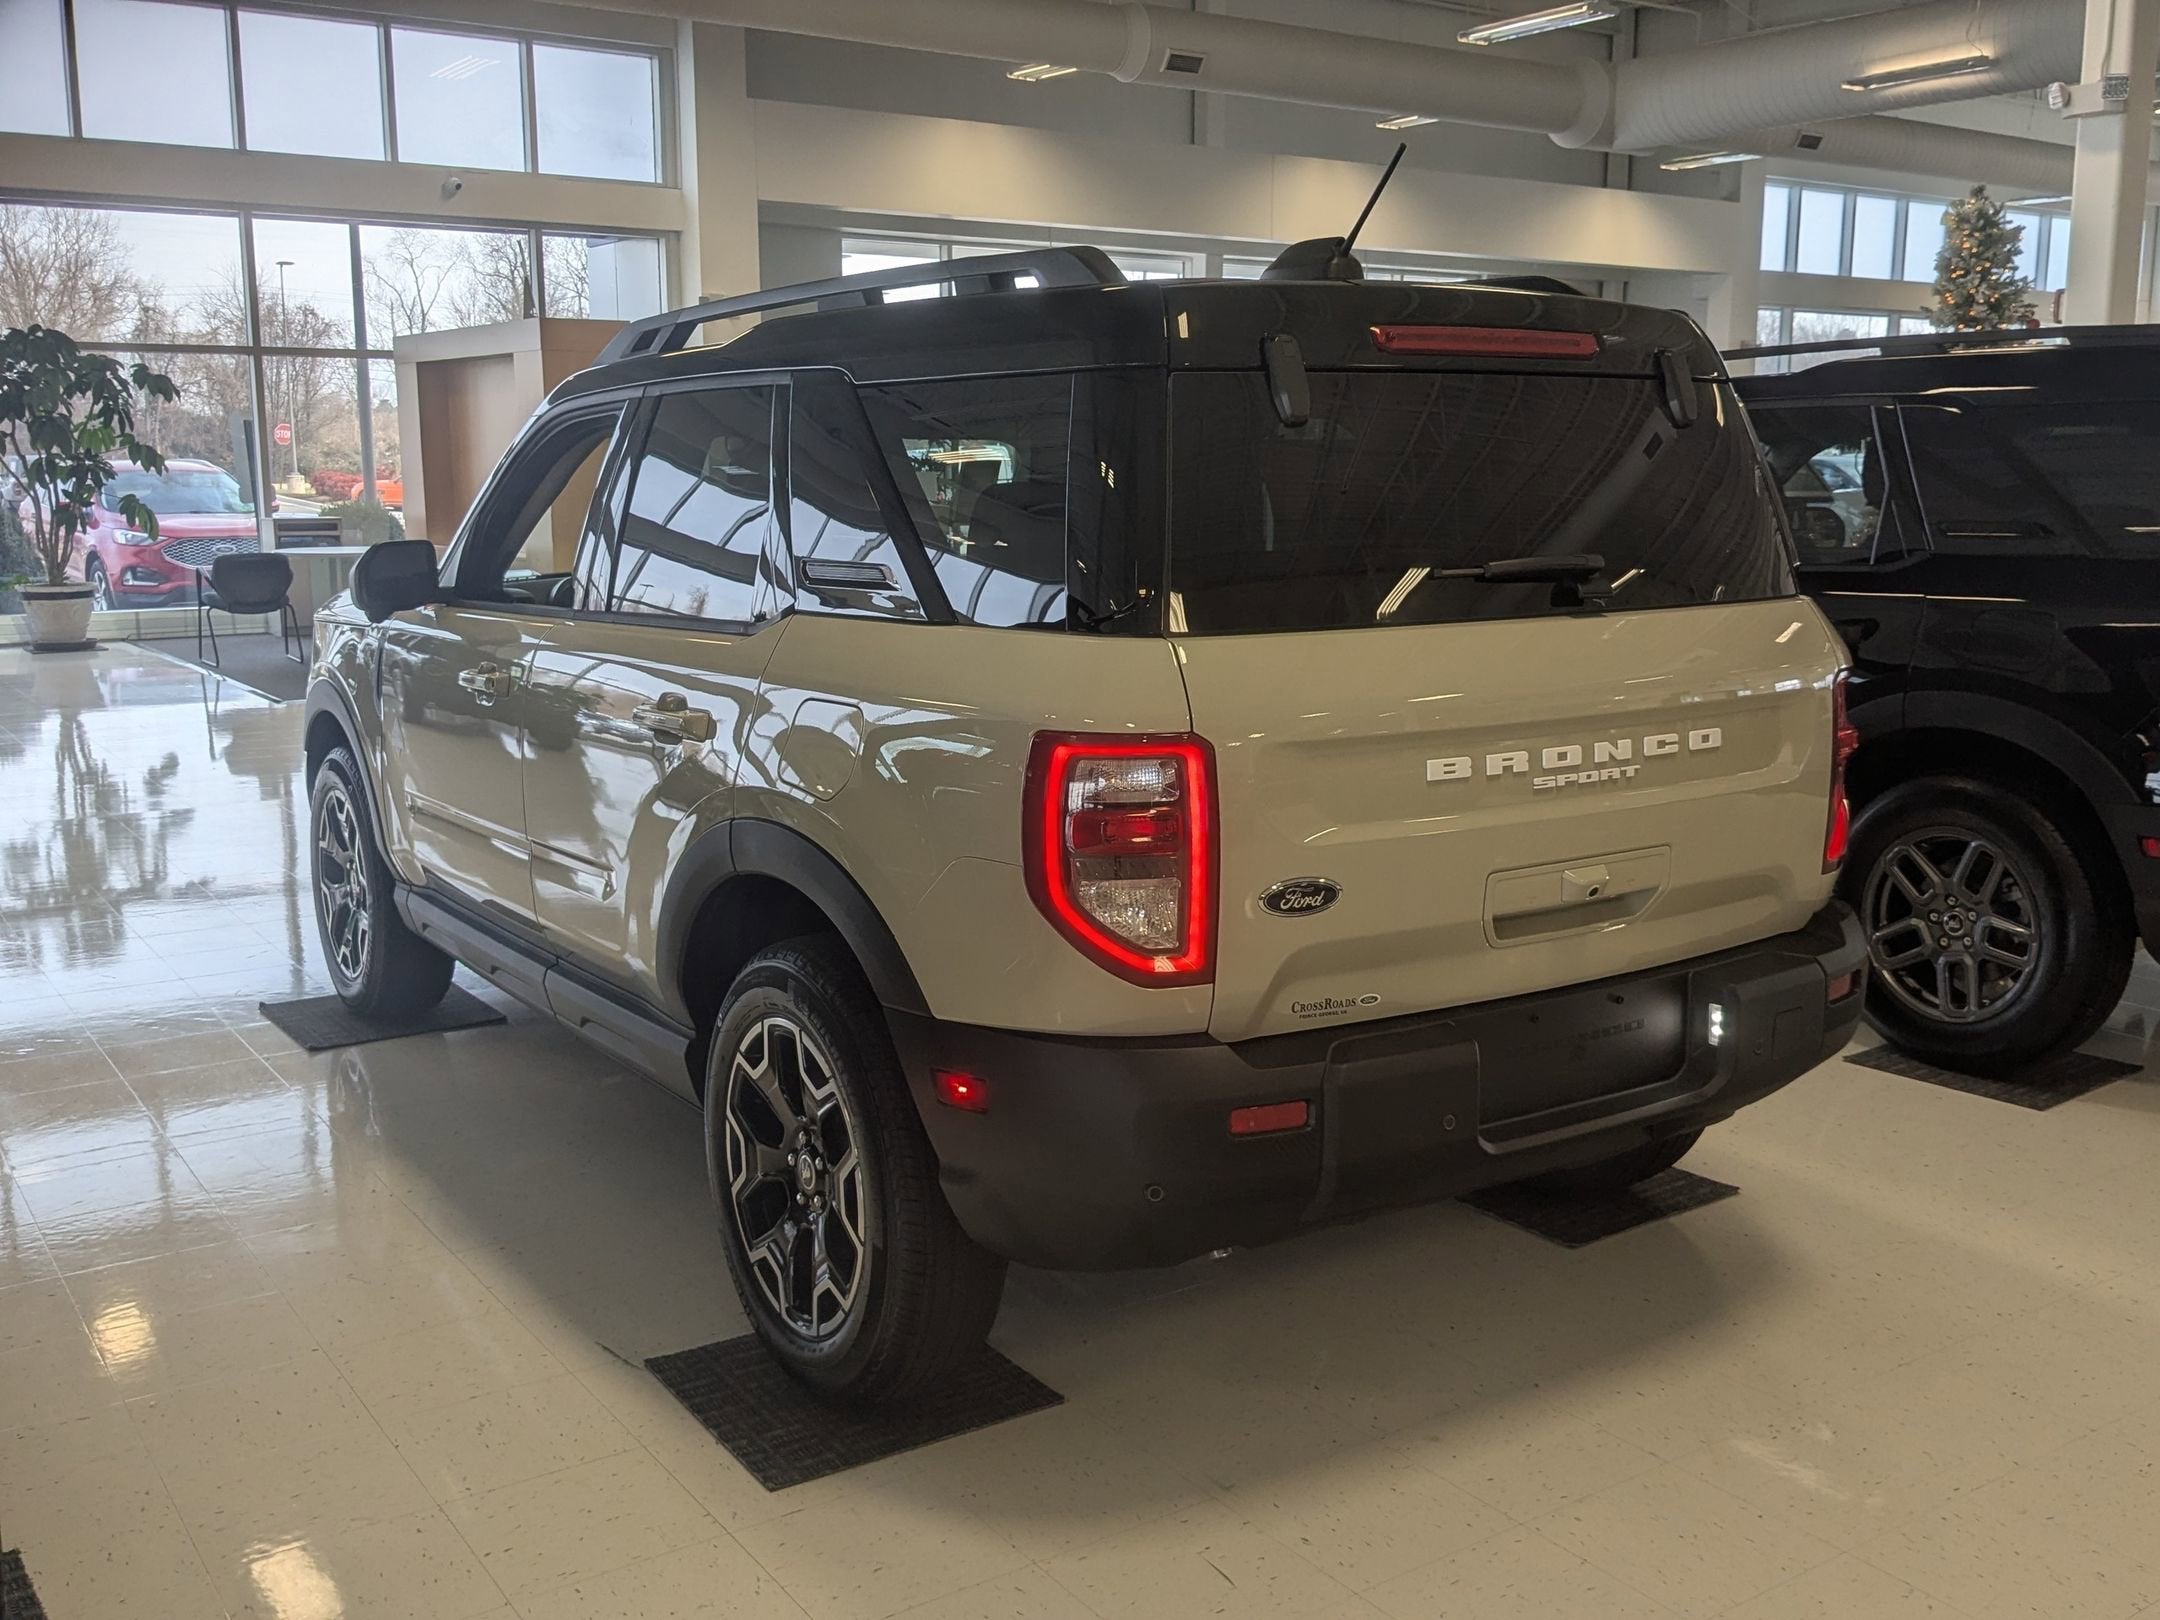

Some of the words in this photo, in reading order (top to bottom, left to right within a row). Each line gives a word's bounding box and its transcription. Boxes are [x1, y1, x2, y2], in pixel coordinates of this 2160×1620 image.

[1426, 727, 1722, 781] BRONCO
[1532, 765, 1641, 789] SPORT
[1280, 885, 1325, 910] Ford
